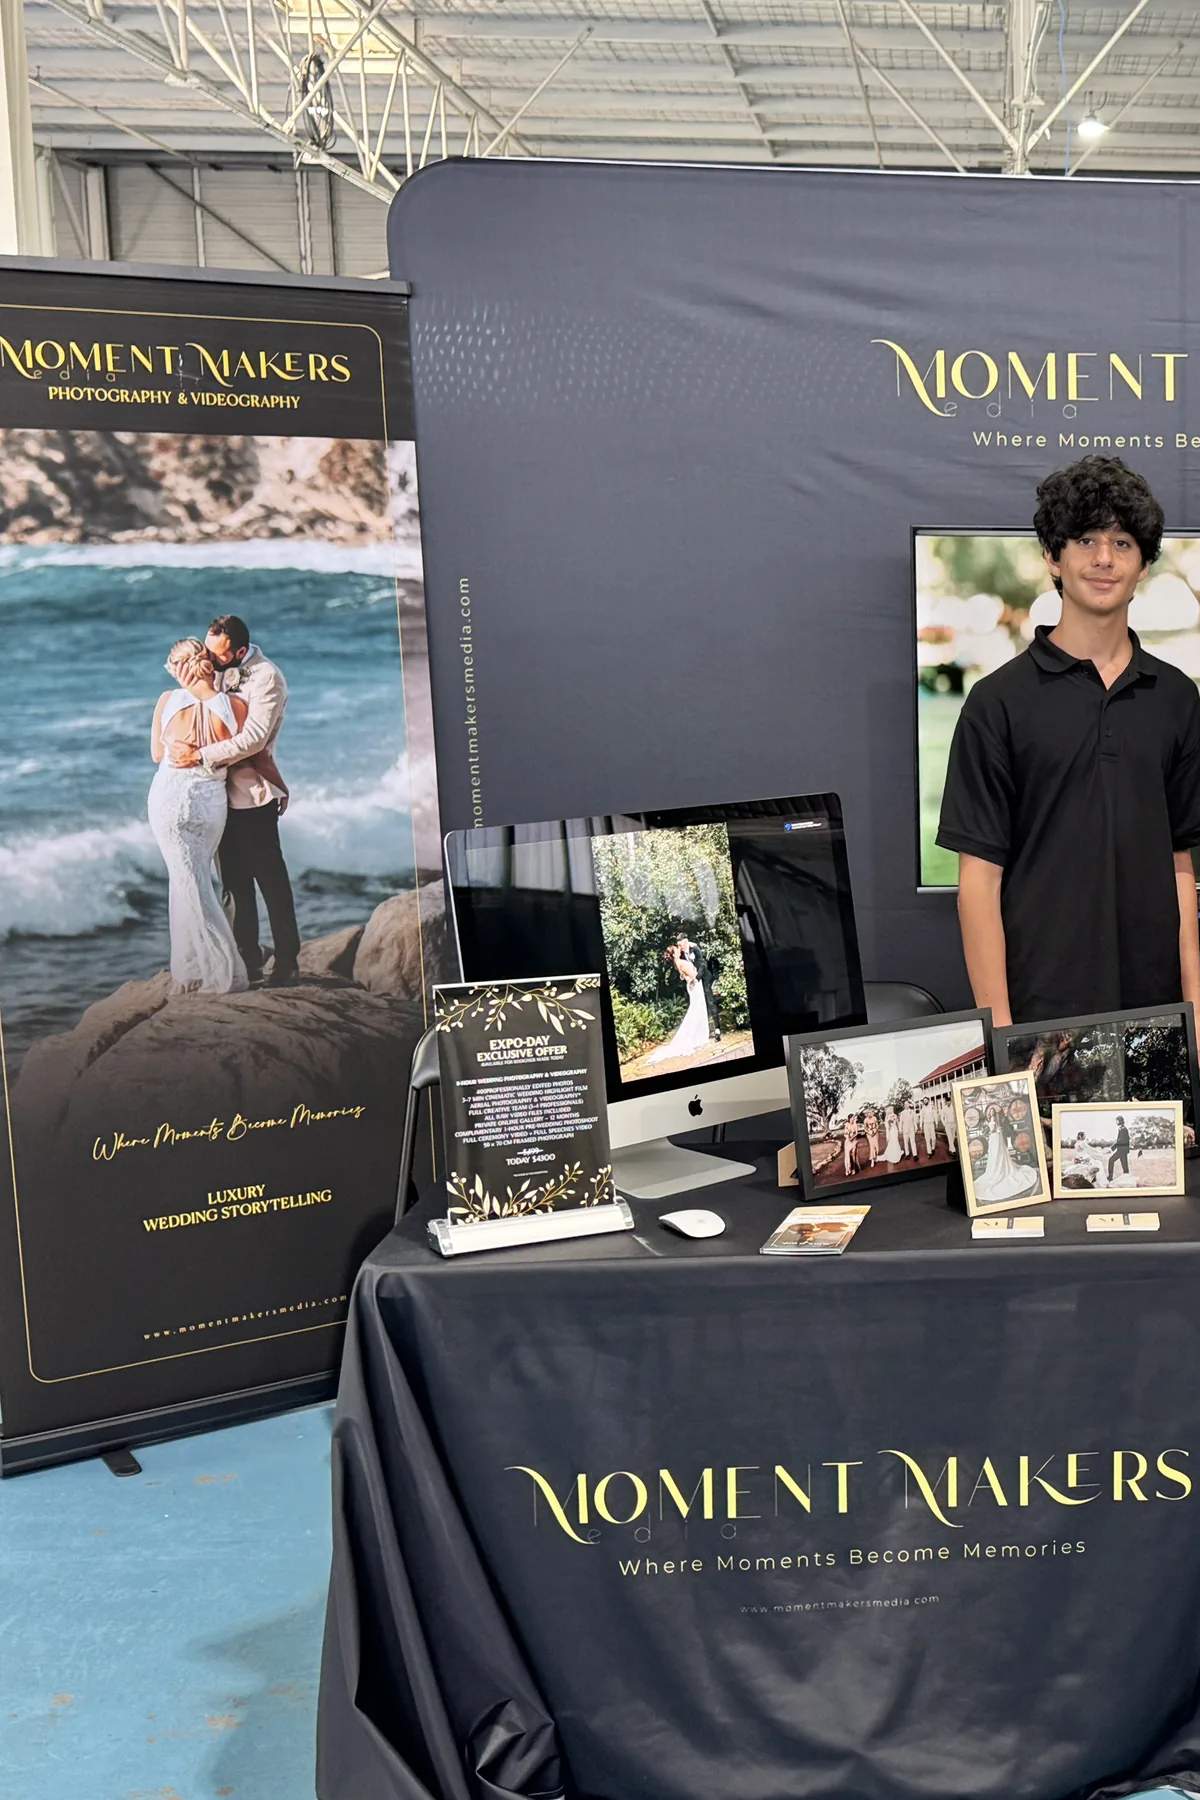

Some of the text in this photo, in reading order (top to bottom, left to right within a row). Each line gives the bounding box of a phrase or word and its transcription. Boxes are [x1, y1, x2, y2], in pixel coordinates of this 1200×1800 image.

[0, 336, 351, 387] MOMENT MAKERS
[870, 339, 1188, 418] MOMENT
[48, 386, 300, 409] PHOTOGRAPHY & VIDEOGRAPHY
[972, 431, 1048, 448] Where
[1058, 432, 1164, 449] Moments
[490, 1036, 550, 1050] EXPO-DAY
[476, 1045, 568, 1062] EXCLUSIVE OFFER
[504, 1073, 544, 1082] PHOTOGRAPHY
[550, 1068, 588, 1077] VIDEOGRAPHY
[485, 1092, 515, 1100] CINEMATIC
[492, 1097, 532, 1106] PHOTOGRAPHY
[92, 1104, 366, 1160] Where Moments Become Memories
[455, 1127, 502, 1137] COMPLIMENTARY
[564, 1117, 599, 1125] PHOTOSHOOT
[478, 1133, 510, 1142] CEREMONY
[538, 1133, 574, 1142] PHOTOGRAPH
[506, 1154, 556, 1166] TODAY $4300
[208, 1184, 266, 1205] LUXURY
[143, 1189, 332, 1232] WEDDING STORYTELLING
[144, 1294, 348, 1340] www.momentmakersmedia.com
[504, 1449, 1193, 1544] MOMENT MAKERS
[618, 1540, 1086, 1576] Where Moments Become Memories
[740, 1594, 940, 1614] www.momentmakersmedia.com
